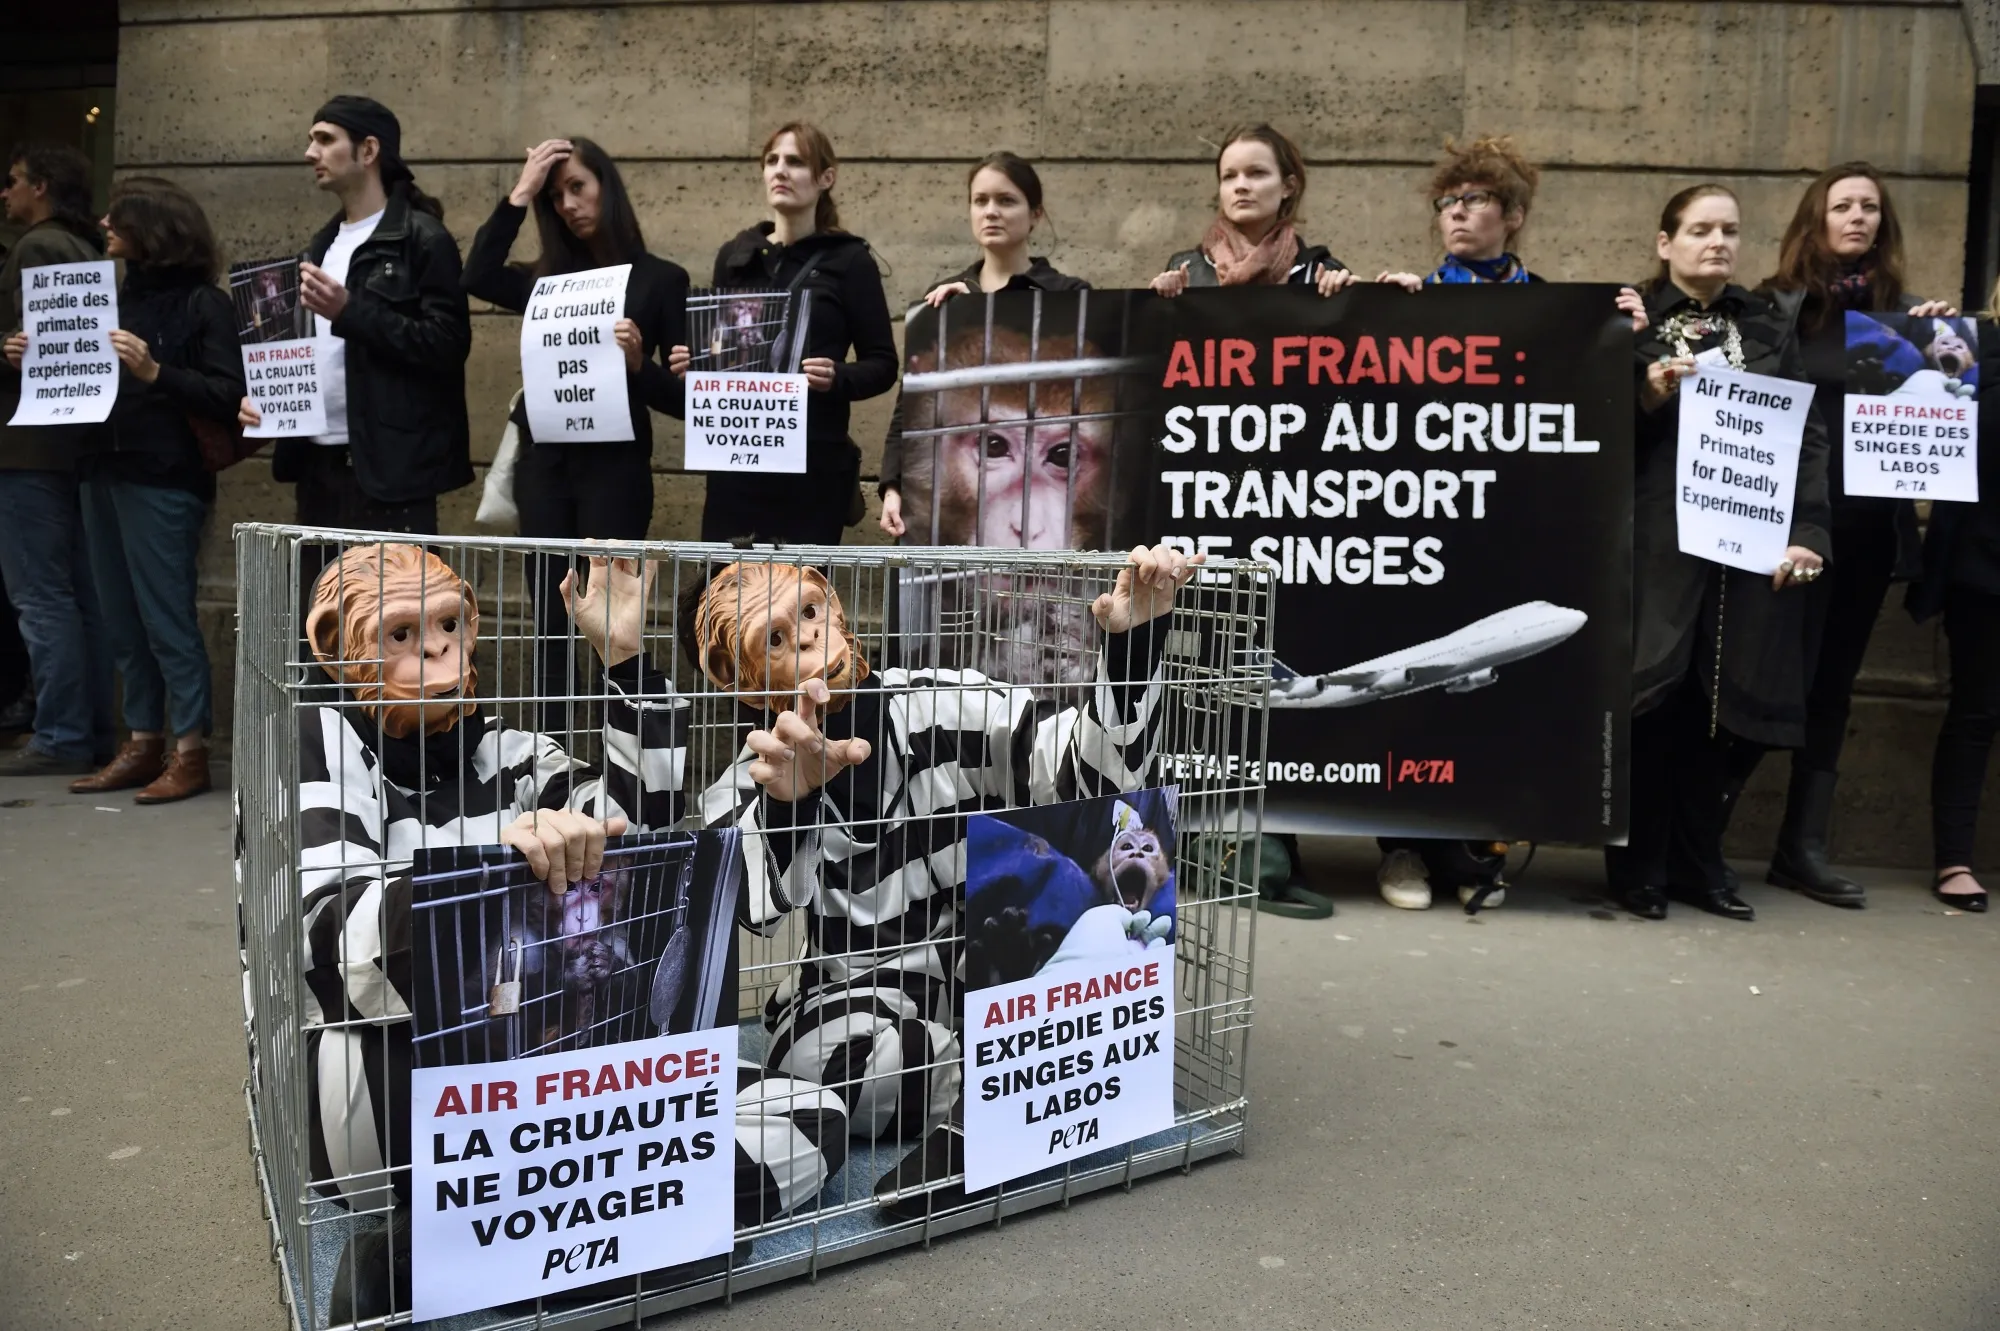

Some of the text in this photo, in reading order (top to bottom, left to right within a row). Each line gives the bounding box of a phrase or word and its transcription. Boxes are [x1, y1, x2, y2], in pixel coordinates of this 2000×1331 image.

[33, 272, 101, 289] Air France
[535, 283, 557, 296] Air
[561, 275, 614, 293] France
[29, 292, 109, 313] expédie des
[531, 299, 615, 320] La cruauté
[37, 316, 98, 336] primates
[543, 327, 600, 347] ne doit
[38, 338, 99, 359] pour des
[249, 351, 265, 363] AIR
[28, 361, 111, 380] expériences
[250, 360, 316, 380] LA CRUAUTÉ
[558, 360, 587, 378] pas
[1163, 339, 1256, 388] AIR
[1273, 336, 1500, 385] FRANCE
[36, 383, 101, 399] mortelles
[252, 382, 317, 396] NE DOIT PAS
[554, 385, 595, 402] voler
[694, 380, 800, 394] AIR FRANCE:
[1696, 378, 1792, 410] Air France
[261, 400, 311, 414] VOYAGER
[693, 398, 798, 411] LA CRUAUTÉ
[1857, 404, 1965, 420] AIR FRANCE
[694, 416, 797, 429] NE DOIT PAS
[1161, 402, 1600, 453] STOP AU CRUEL
[1716, 410, 1763, 435] Ships
[1852, 419, 1969, 439] EXPÉDIE DES
[706, 434, 784, 447] VOYAGER
[1701, 434, 1774, 465] Primates
[1855, 440, 1964, 457] SINGES AUX
[1881, 460, 1939, 474] LABOS
[1693, 460, 1778, 497] for Deadly
[1161, 469, 1496, 519] TRANSPORT
[1682, 486, 1785, 525] Experiments
[1249, 535, 1445, 585] SINGES
[1160, 754, 1381, 784] PETAFrance.com
[984, 962, 1160, 1028] AIR FRANCE
[975, 996, 1164, 1068] EXPÉDIE DES
[981, 1031, 1159, 1101] SINGES AUX
[434, 1048, 720, 1117] AIR FRANCE:
[1026, 1076, 1120, 1125] LABOS
[434, 1081, 719, 1164] LA CRUAUTÉ
[437, 1131, 715, 1211] NE DOIT PAS
[471, 1179, 684, 1248] VOYAGER
